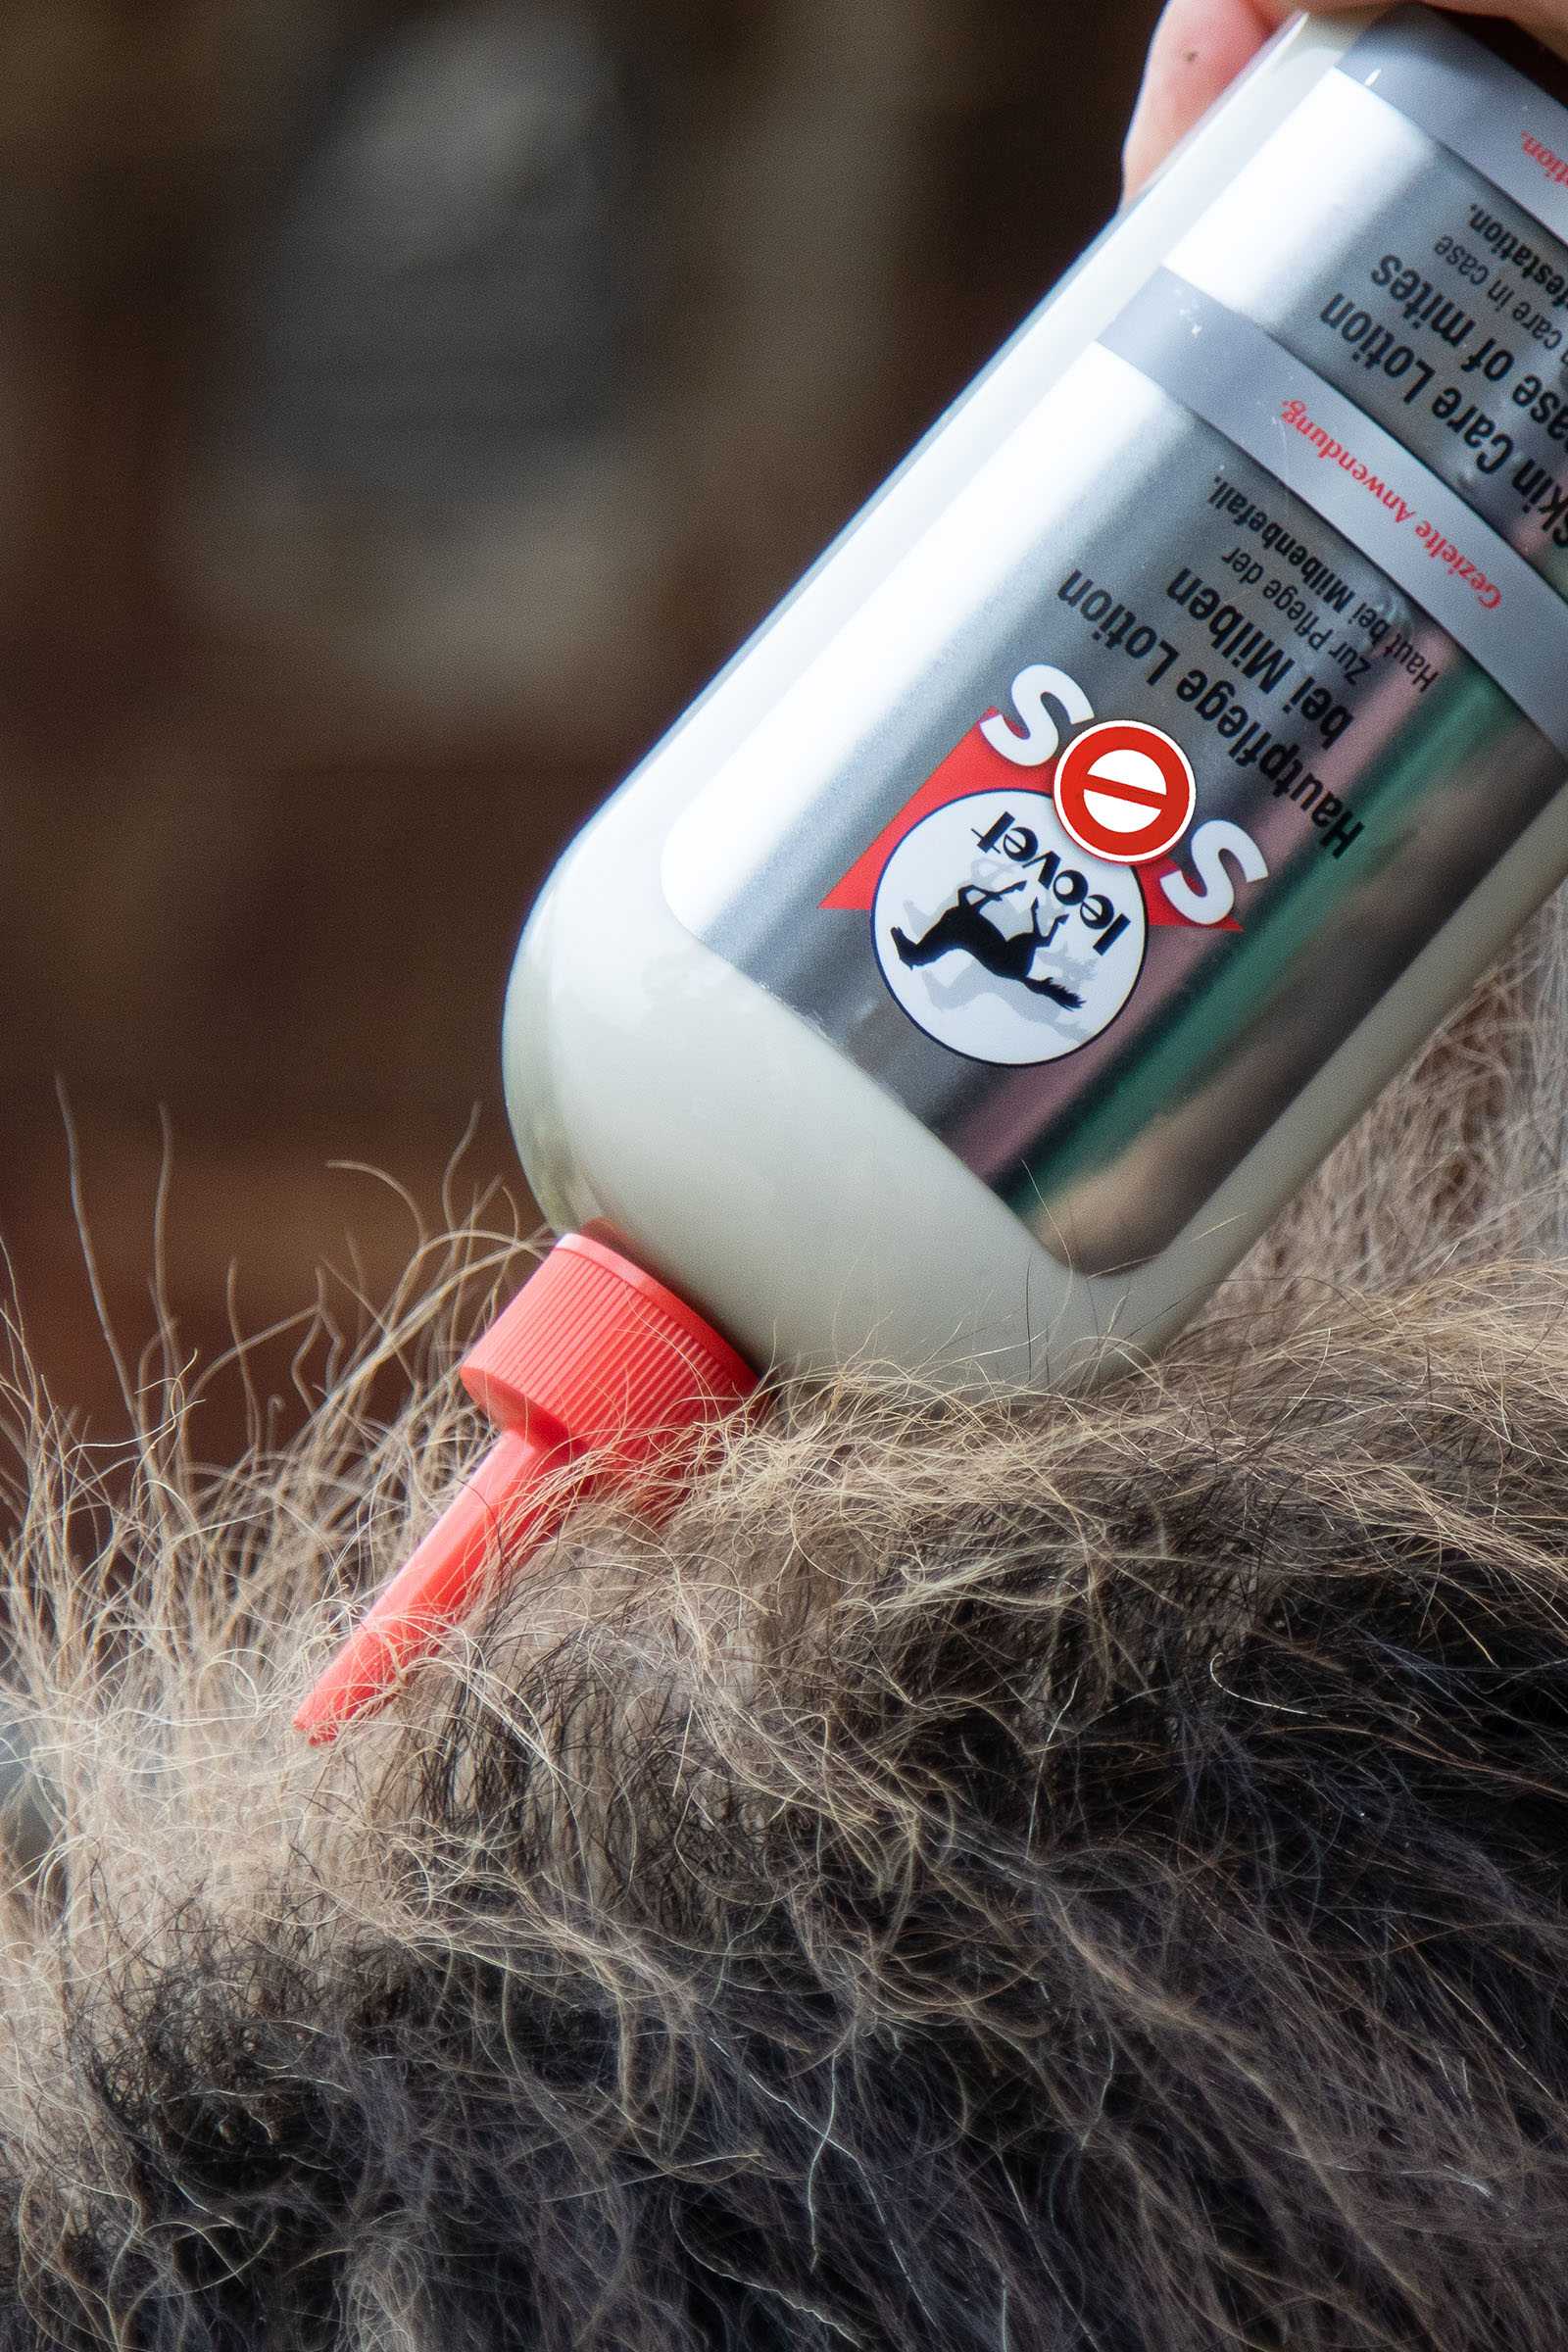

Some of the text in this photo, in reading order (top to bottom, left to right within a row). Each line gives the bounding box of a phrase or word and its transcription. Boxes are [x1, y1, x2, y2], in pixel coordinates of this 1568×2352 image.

[1320, 292, 1436, 405] Lotion
[1371, 254, 1568, 451] ase of mites
[1434, 235, 1563, 350] care in case
[1281, 398, 1502, 610] Gezielte Anwendung.
[1432, 386, 1514, 474] Care
[1166, 567, 1354, 751] bei Milben
[1207, 473, 1440, 693] Haut bei Milbenbefall.
[1221, 546, 1372, 686] Zur Pflege der
[1057, 568, 1366, 860] Hautpflege Lotion
[970, 810, 1132, 956] leovet
